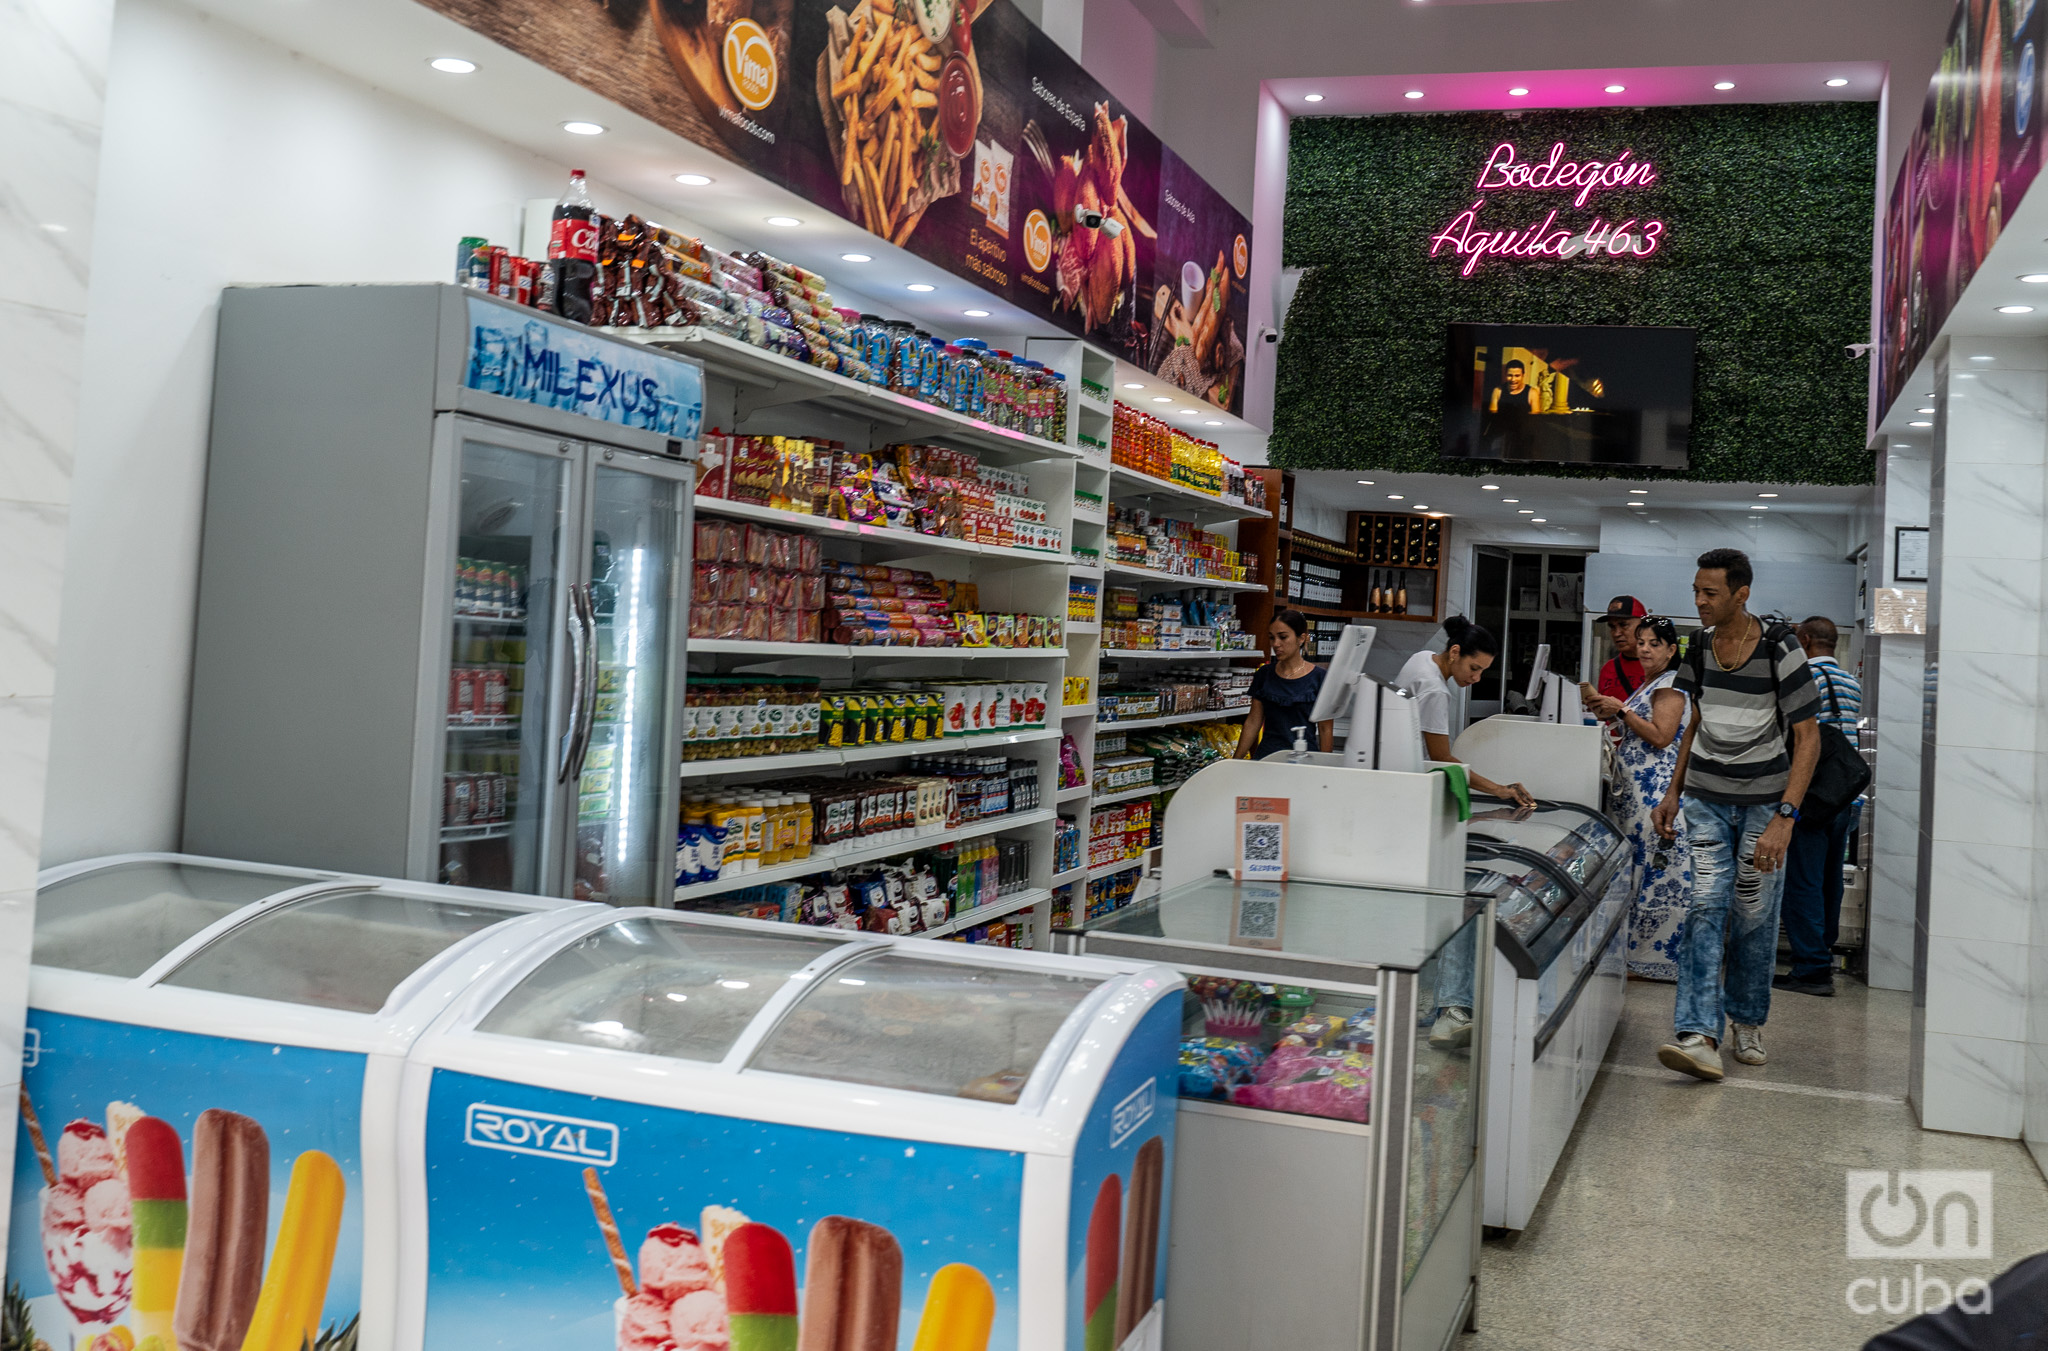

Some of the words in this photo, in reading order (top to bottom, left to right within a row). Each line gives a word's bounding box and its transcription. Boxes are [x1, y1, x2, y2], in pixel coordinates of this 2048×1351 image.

[728, 34, 774, 89] Vima
[1031, 76, 1056, 108] Sabores
[1056, 97, 1066, 115] de
[1065, 103, 1086, 132] España
[1475, 141, 1657, 208] Bodegón
[970, 228, 978, 246] El
[978, 236, 1007, 263] aperitivo
[1026, 220, 1048, 257] Vima
[1430, 199, 1577, 277] Águila
[1582, 219, 1664, 257] 463
[965, 254, 982, 273] más
[982, 262, 1008, 287] sabroso
[523, 343, 660, 419] MILEXUS
[475, 1112, 608, 1158] ROYAL
